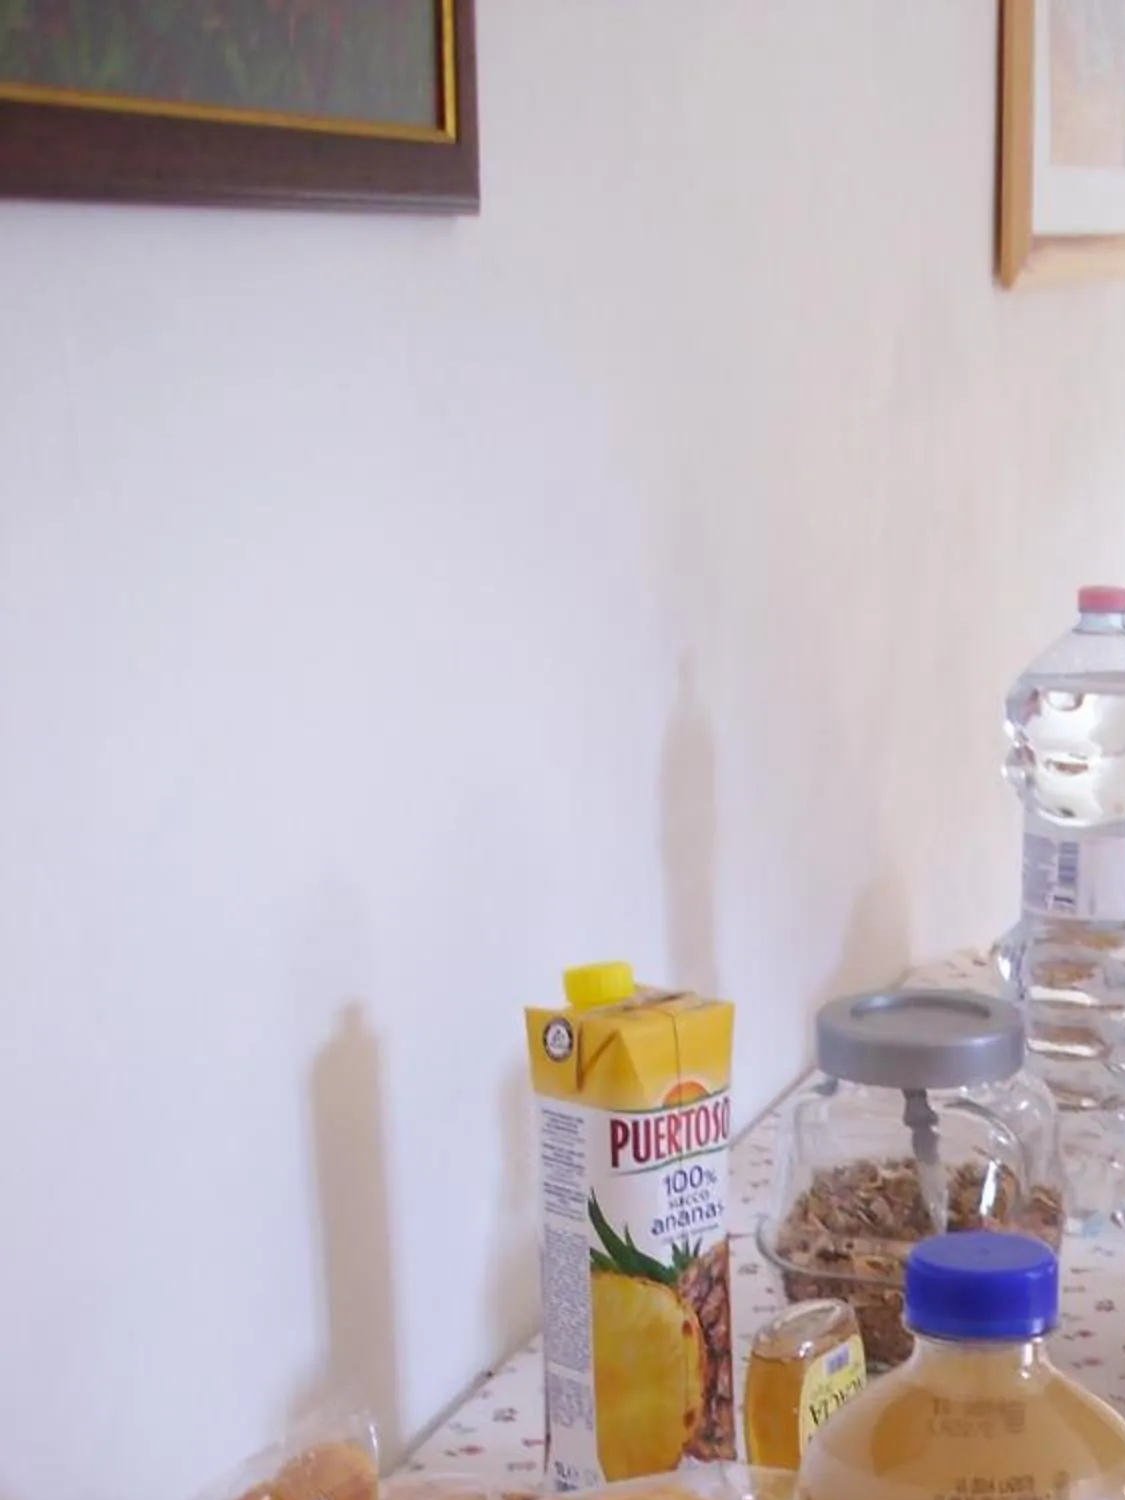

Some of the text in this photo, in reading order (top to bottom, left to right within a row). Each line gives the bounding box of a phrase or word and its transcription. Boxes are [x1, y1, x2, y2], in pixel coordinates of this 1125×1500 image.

[609, 1097, 730, 1168] PUERTOSO
[664, 1165, 717, 1196] 100%
[651, 1202, 724, 1237] ananas
